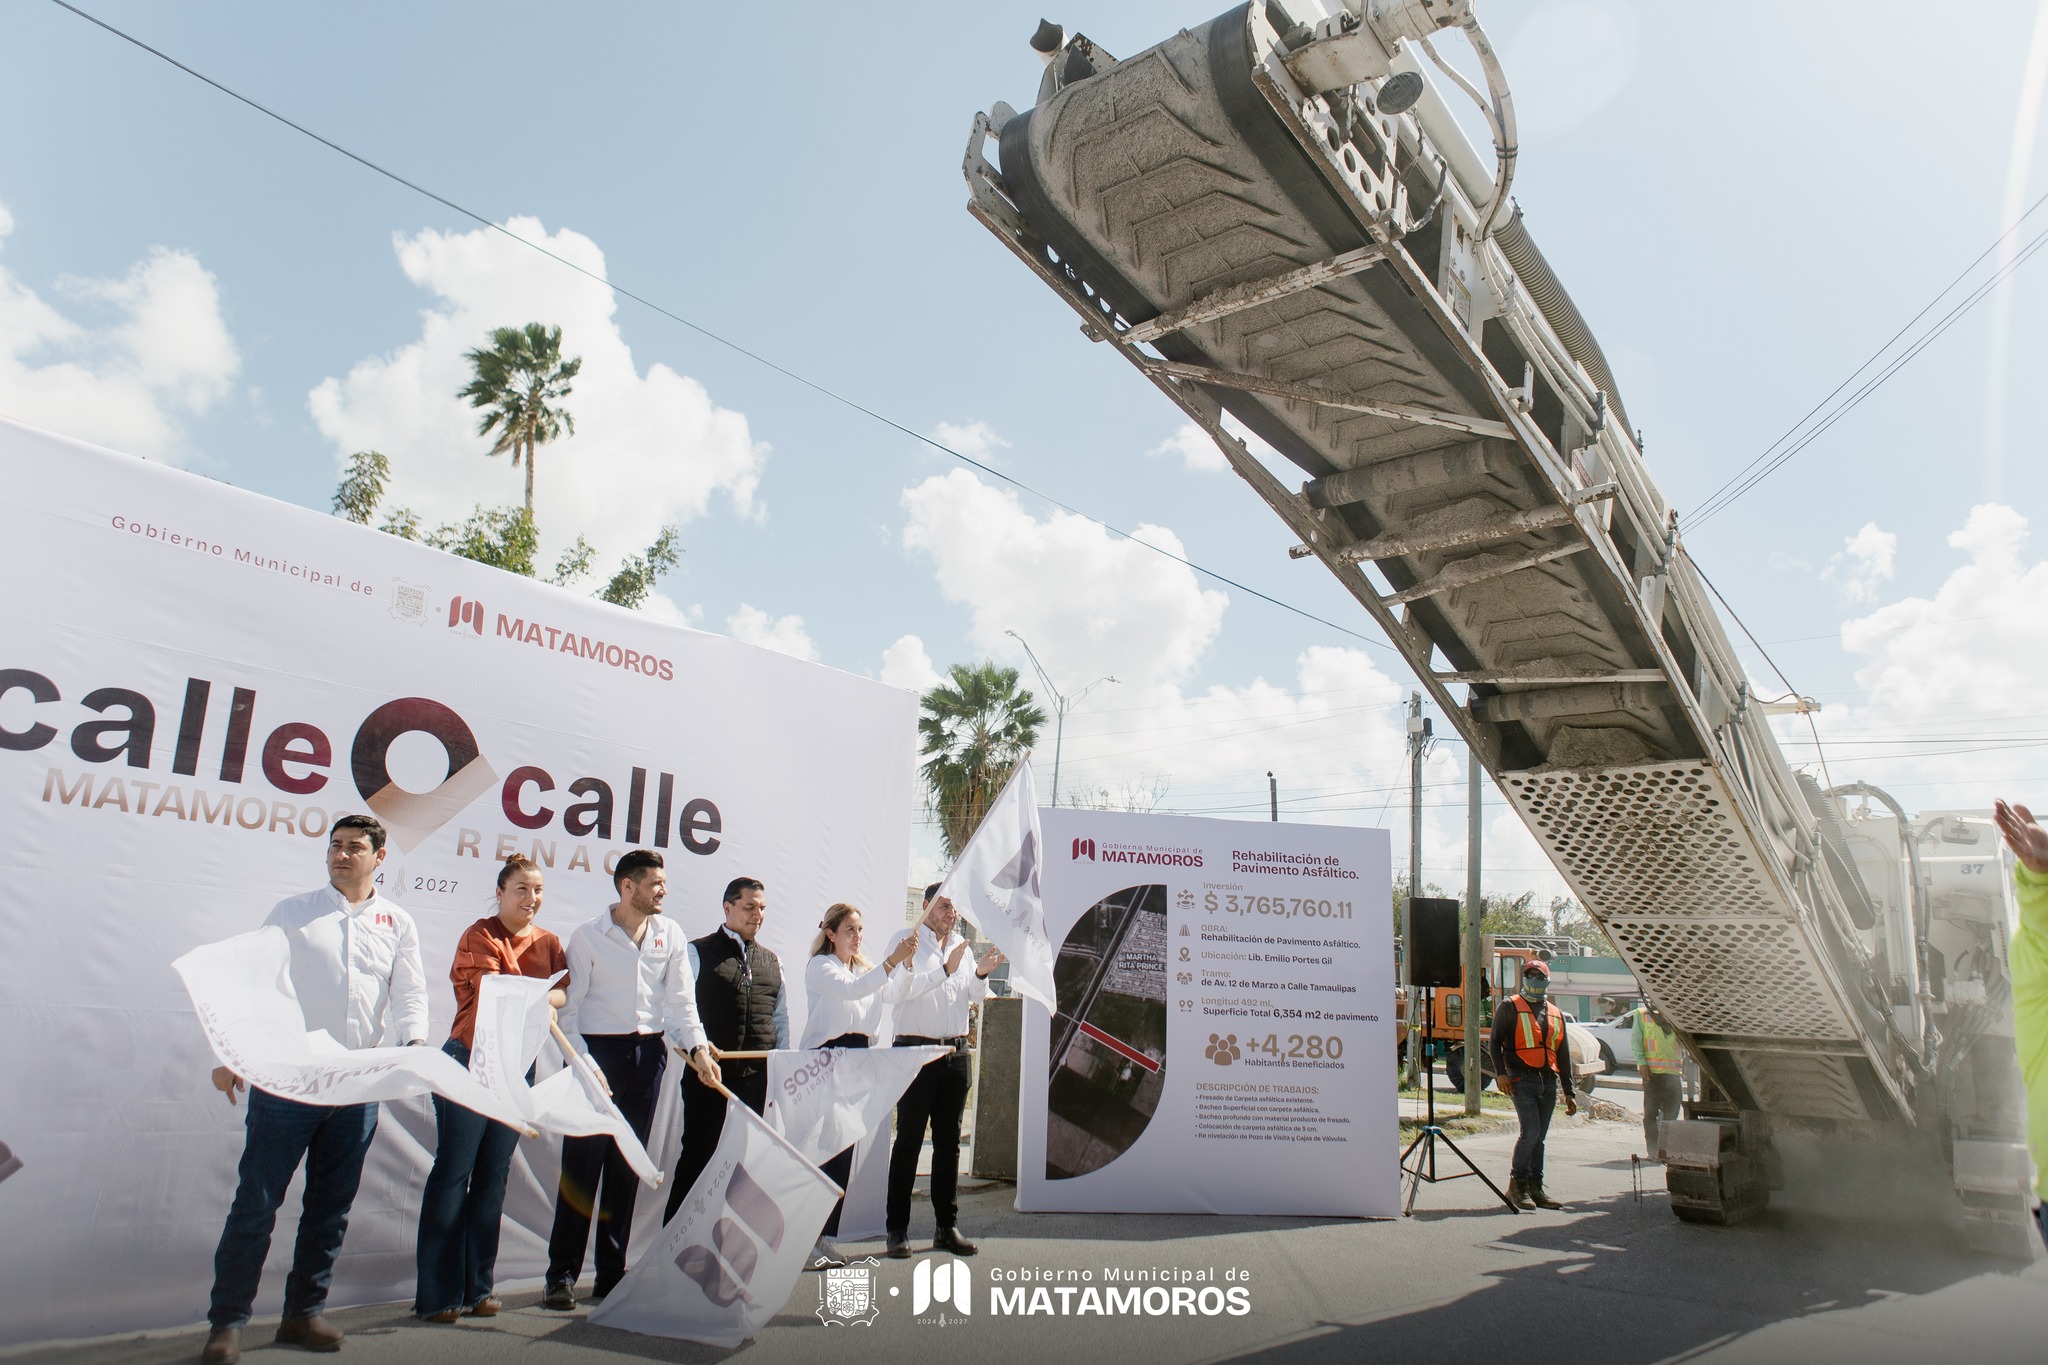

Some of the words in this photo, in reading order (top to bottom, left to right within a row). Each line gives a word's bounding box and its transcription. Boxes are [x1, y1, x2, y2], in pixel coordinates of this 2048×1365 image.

[112, 516, 222, 556] Gobierno
[234, 548, 341, 587] Municipal
[350, 581, 373, 596] de
[496, 614, 674, 681] MATAMOROS
[0, 668, 332, 796] calle
[502, 766, 722, 856] calle
[456, 827, 622, 877] RENAC
[1102, 842, 1142, 850] Gobierno
[1146, 845, 1189, 854] Municipal
[1102, 850, 1203, 868] MATAMOROS
[1232, 850, 1320, 865] Rehabilitación
[1324, 855, 1339, 866] de
[1232, 862, 1299, 876] Pavimento
[1302, 866, 1360, 880] Asfáltico.
[414, 876, 458, 893] 2027
[1203, 882, 1243, 891] Inversión
[986, 892, 1012, 916] 2024
[1204, 891, 1218, 914] $
[1225, 894, 1352, 919] 3,765,760.11
[1201, 924, 1228, 932] OBRA:
[1201, 933, 1262, 944] Rehabilitación
[1277, 937, 1320, 947] Pavimento
[1323, 940, 1361, 949] Asfáltico.
[1126, 953, 1157, 961] MARTHA
[1201, 951, 1246, 961] Ubicación:
[1248, 954, 1262, 962] Lib.
[1265, 954, 1290, 963] Emilio
[1292, 956, 1320, 964] Portes
[1322, 957, 1332, 965] Gil
[1136, 962, 1164, 971] PRINCE
[1202, 969, 1231, 978] Tramo:
[1201, 978, 1212, 986] de
[1214, 979, 1227, 987] Av.
[1228, 980, 1237, 988] 12
[1239, 980, 1250, 988] de
[1252, 981, 1278, 990] Marzo
[1288, 982, 1308, 990] Calle
[1310, 984, 1356, 994] Tamaulipas
[1201, 996, 1239, 1006] Longitud
[1242, 998, 1258, 1006] 492
[1203, 1007, 1248, 1016] Superficie
[1250, 1008, 1270, 1018] Total
[1273, 1008, 1302, 1020] 6,354
[1304, 1010, 1322, 1019] m2
[1324, 1012, 1334, 1020] de
[1336, 1012, 1378, 1022] pavimento
[1246, 1034, 1343, 1061] +4,280
[1244, 1058, 1290, 1068] Habitantes
[1292, 1060, 1345, 1069] Beneficiados
[784, 1050, 832, 1096] OROS
[1196, 1082, 1257, 1092] DESCRIPCIÓN
[1258, 1084, 1270, 1092] DE
[1272, 1086, 1319, 1094] TRABAJOS:
[708, 1160, 731, 1196] 2024
[669, 1216, 694, 1252] 2027
